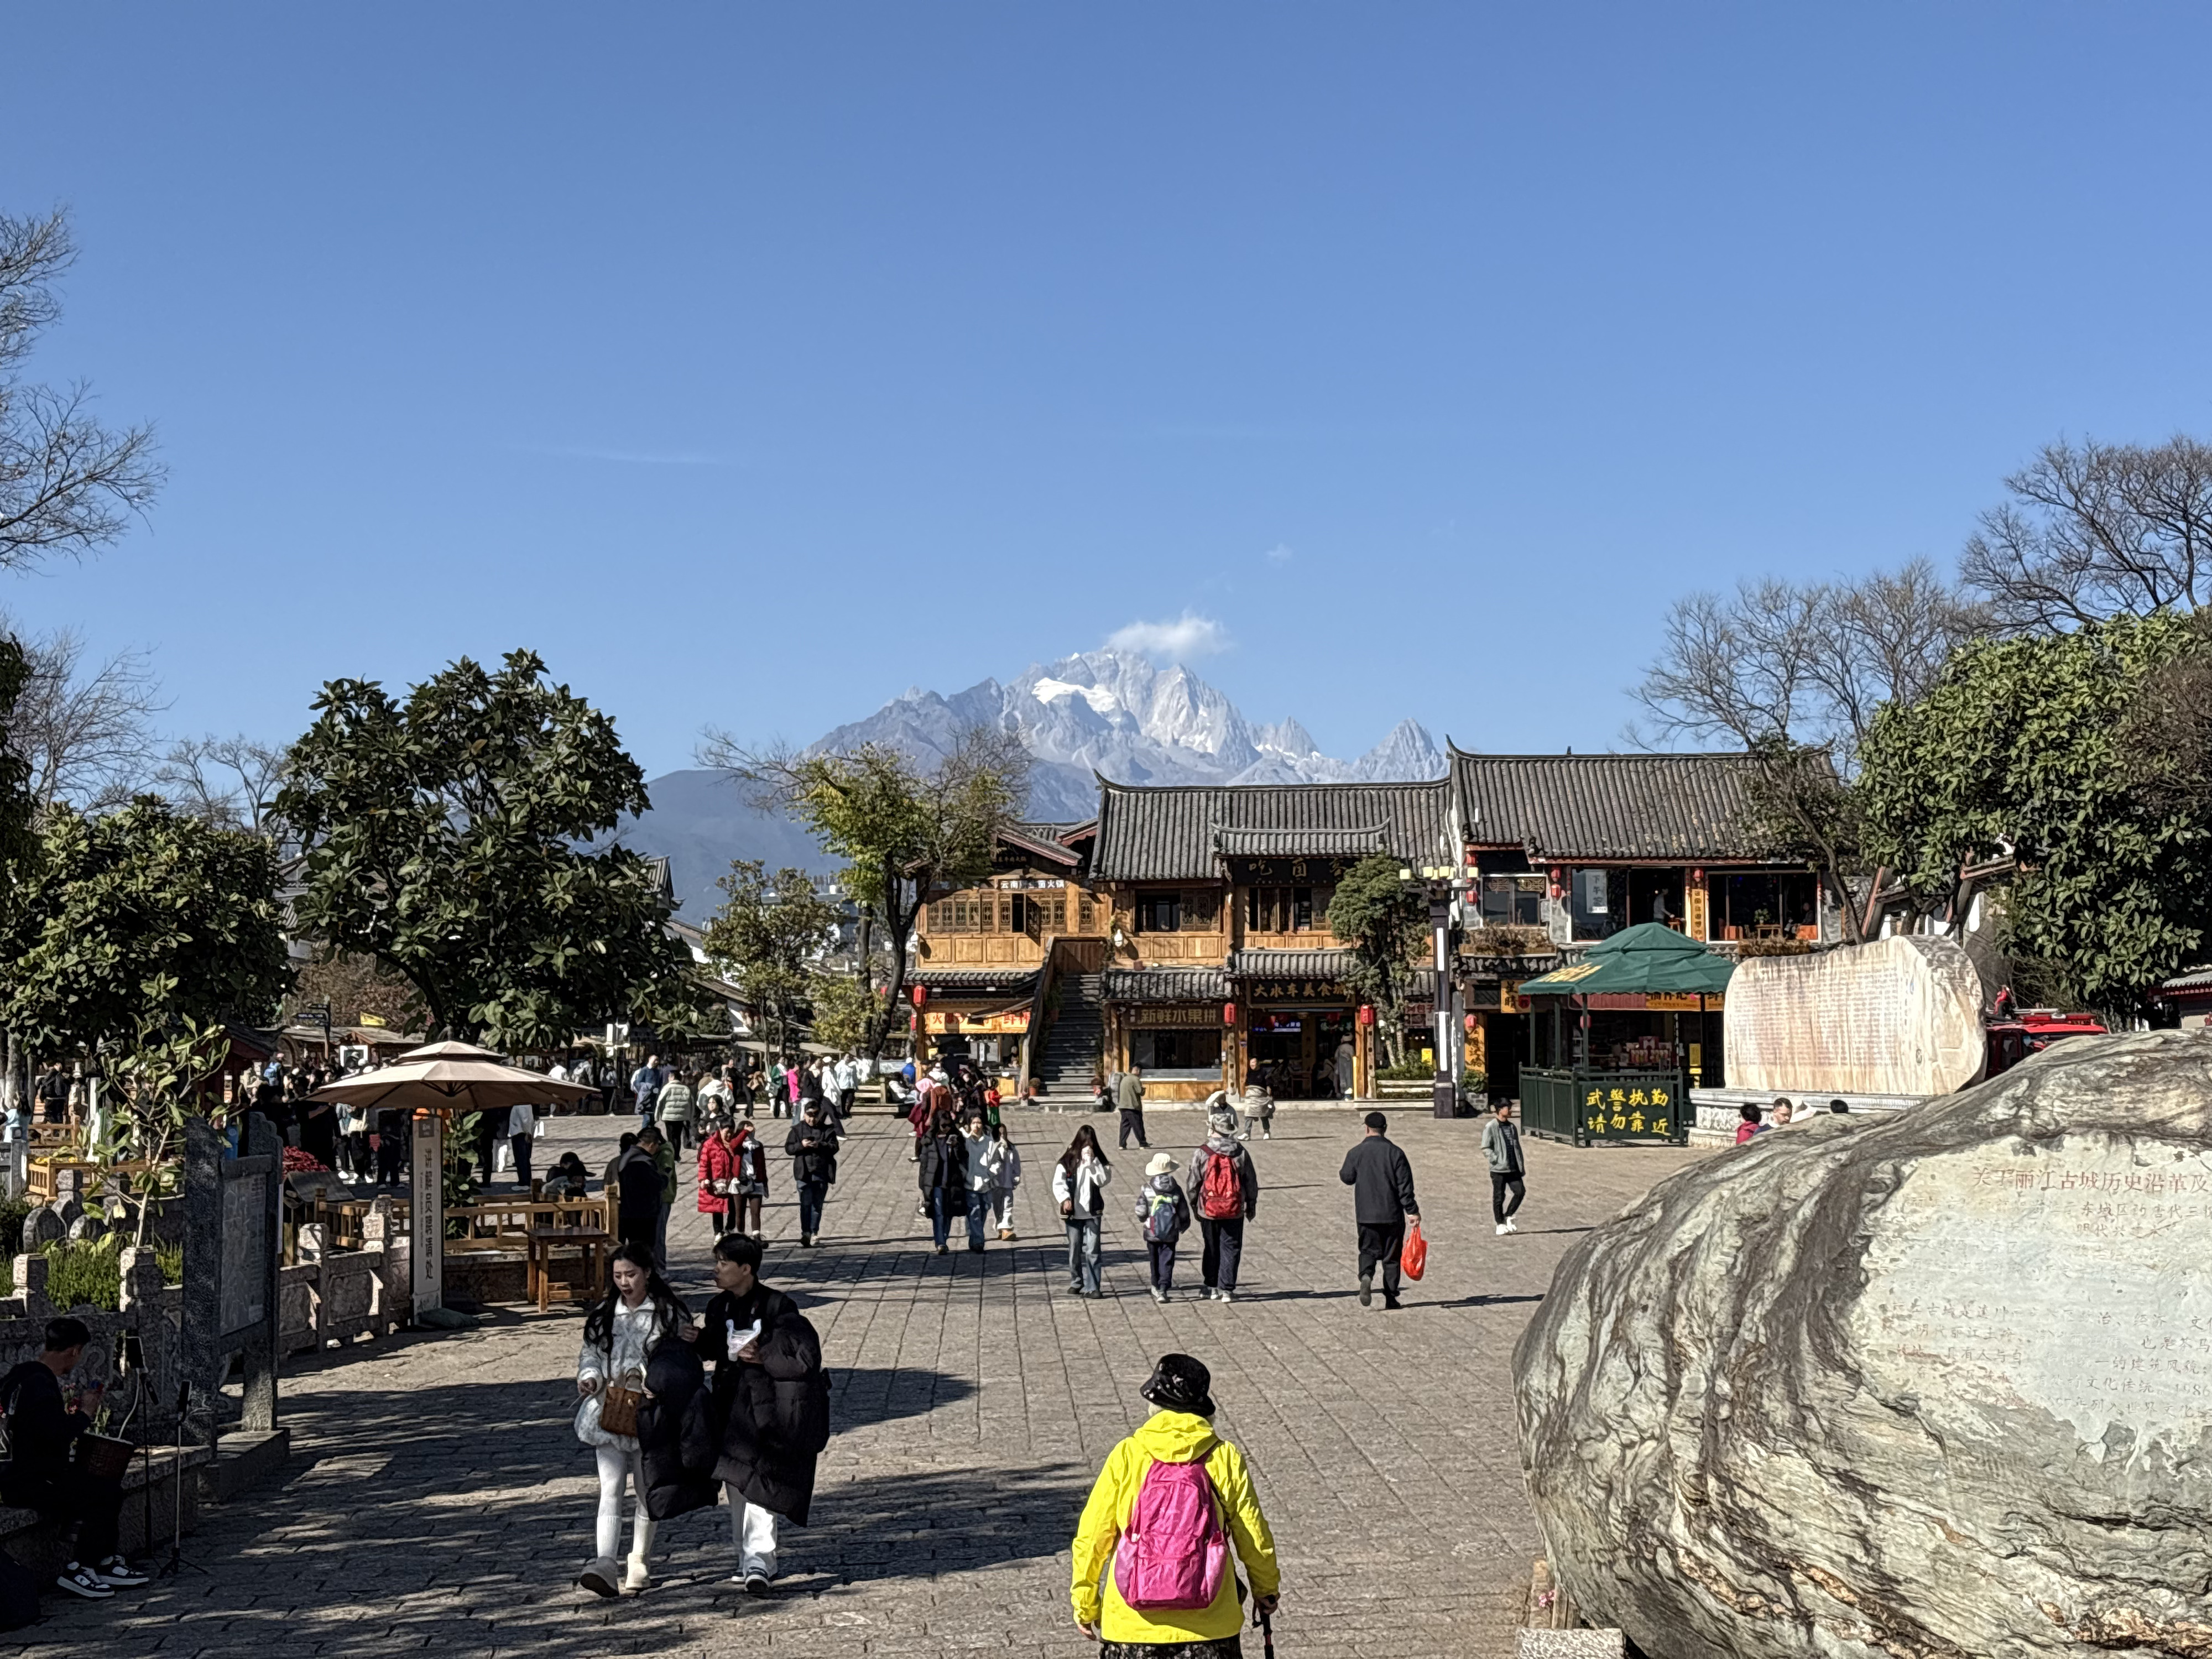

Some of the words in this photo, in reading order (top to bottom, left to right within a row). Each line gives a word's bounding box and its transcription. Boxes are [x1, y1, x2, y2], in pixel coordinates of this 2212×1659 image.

[1254, 982, 1347, 998] 大水车美食城
[1140, 1009, 1217, 1024] 新鲜水果拼
[1586, 1088, 1668, 1112] 武警执勤
[1588, 1110, 1671, 1136] 请勿靠近
[1971, 1166, 2209, 1194] 关于丽江古城历史沿革及
